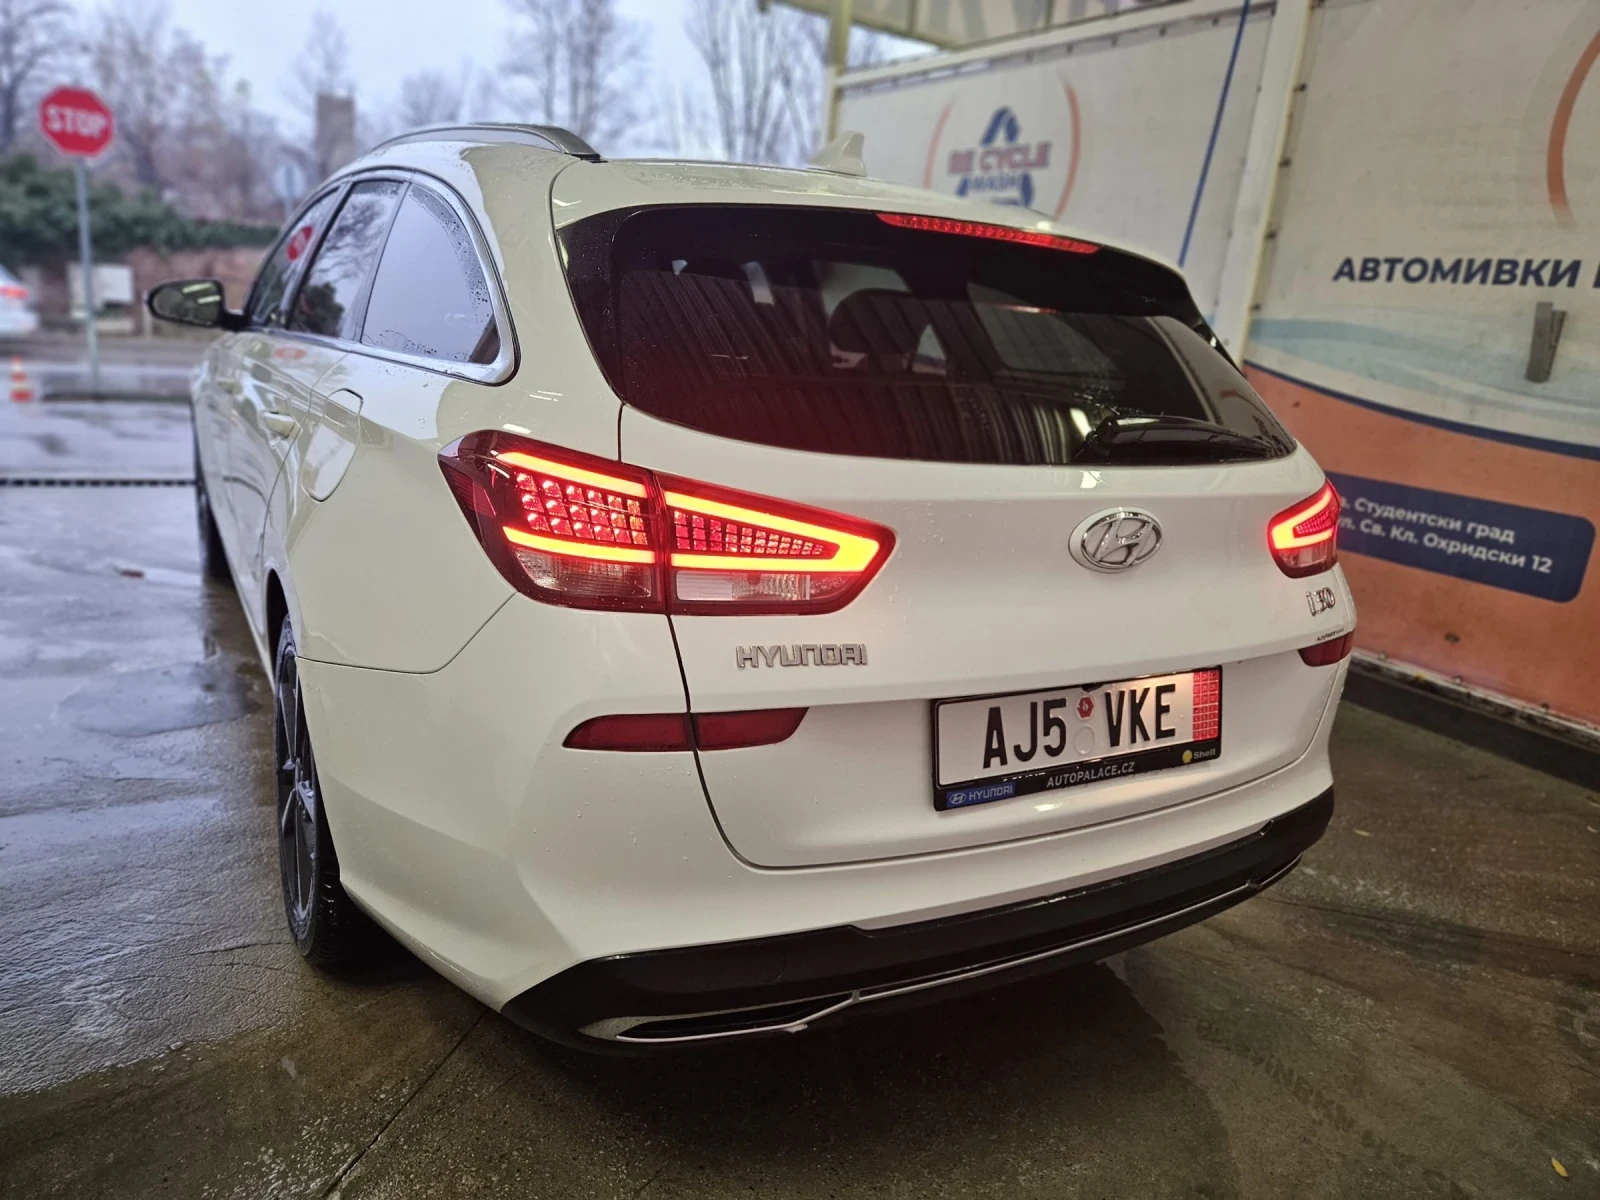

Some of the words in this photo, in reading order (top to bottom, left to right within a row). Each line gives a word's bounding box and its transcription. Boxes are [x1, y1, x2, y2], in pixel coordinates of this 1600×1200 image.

[45, 104, 106, 137] STOP
[979, 141, 1051, 171] CYCLE
[1332, 256, 1582, 288] АВТОМИВКИ
[1354, 496, 1462, 533] Студентски
[1466, 522, 1516, 545] град
[1360, 519, 1386, 537] Св.
[1389, 525, 1418, 545] Кл.
[1423, 533, 1527, 568] Охридски
[1531, 554, 1553, 573] 12
[735, 643, 868, 669] HYUNDAI
[982, 697, 1067, 769] AJ5
[1104, 683, 1176, 748] VKE
[1193, 748, 1217, 760] Shell
[1046, 761, 1136, 789] AUTOPALACE.CZ
[968, 784, 1014, 802] HYUNDAI
